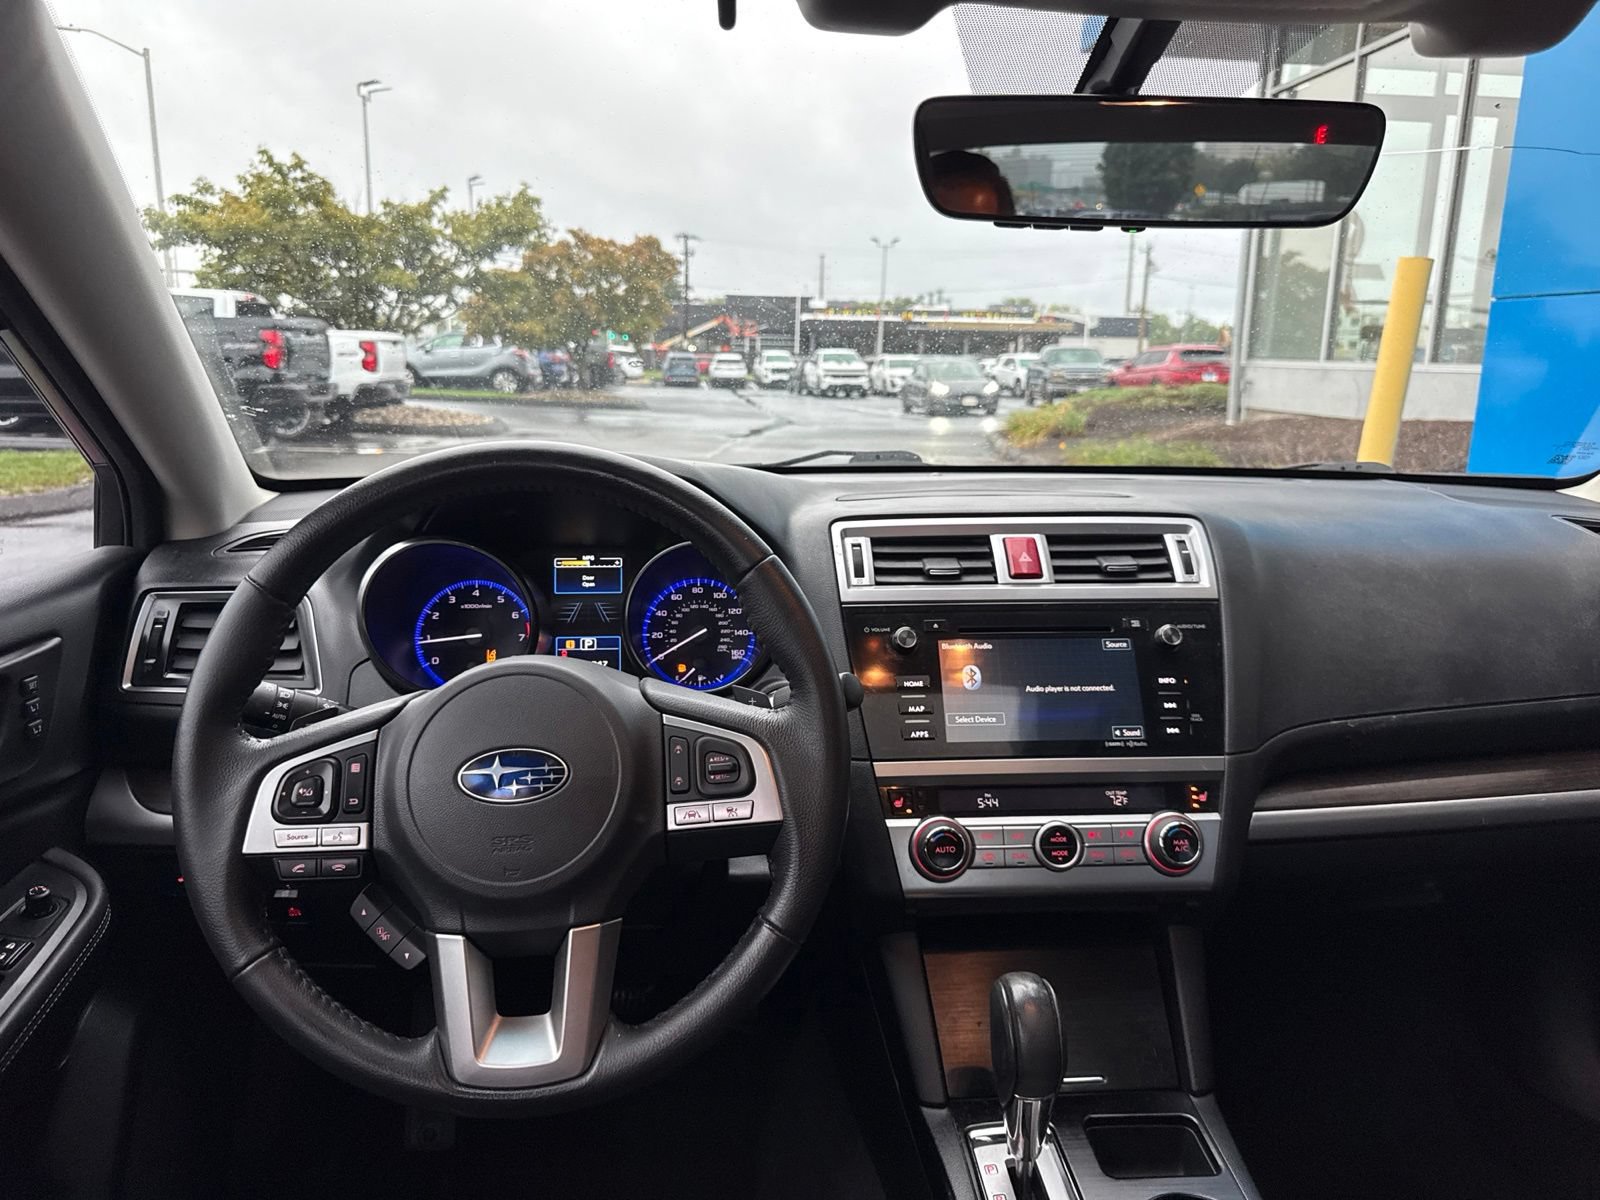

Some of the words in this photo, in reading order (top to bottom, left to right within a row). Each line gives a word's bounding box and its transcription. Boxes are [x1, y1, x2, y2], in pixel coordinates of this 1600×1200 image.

[1316, 125, 1327, 144] E
[448, 596, 456, 604] 3
[671, 593, 682, 601] 60
[432, 612, 439, 620] 2
[512, 611, 519, 619] 6
[431, 657, 439, 665] 0
[1045, 685, 1064, 694] player
[1123, 729, 1141, 737] Sound
[977, 797, 999, 808] 5:44
